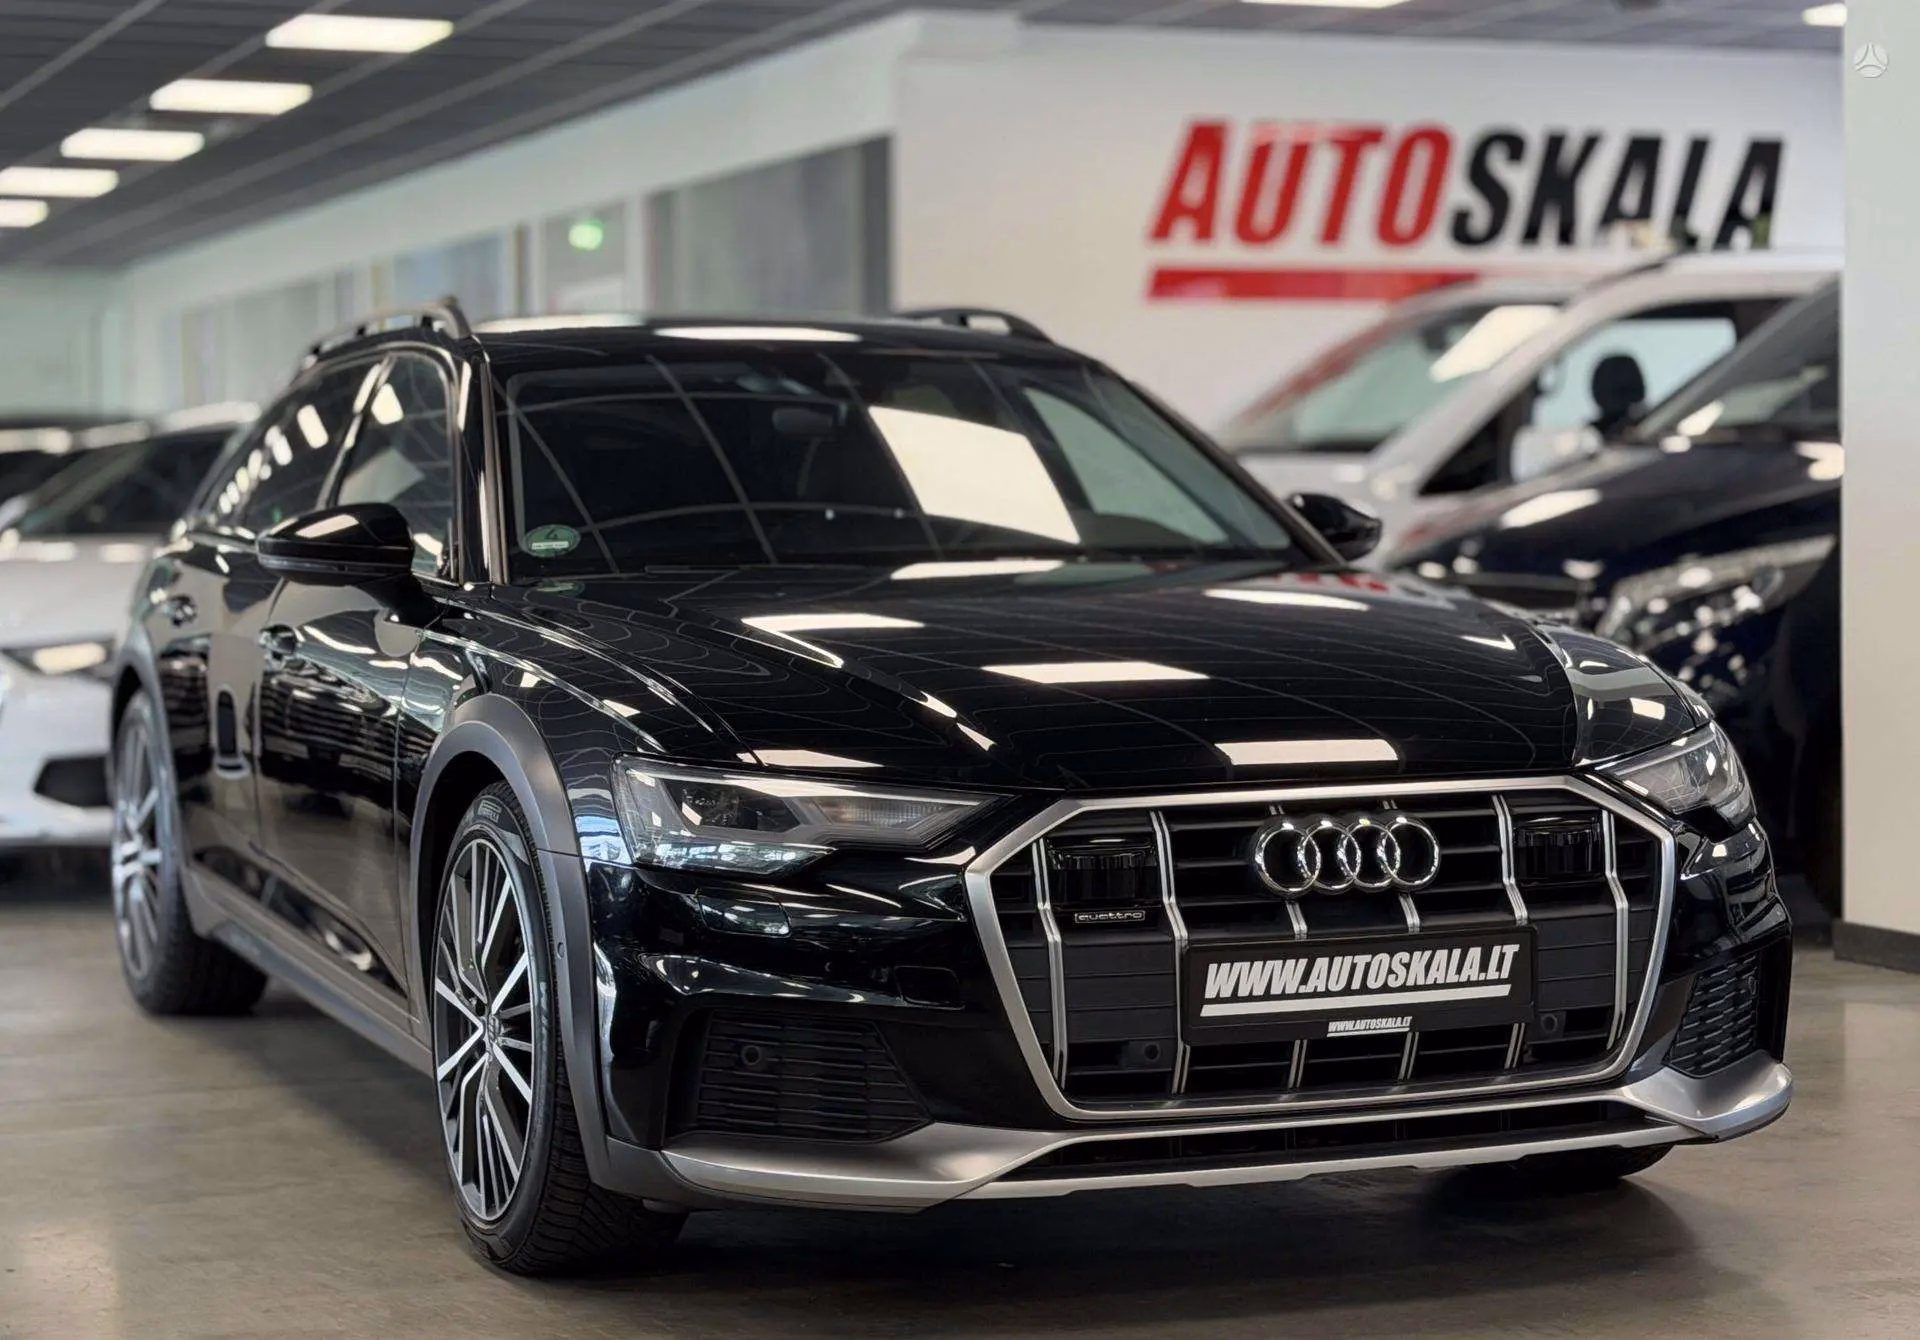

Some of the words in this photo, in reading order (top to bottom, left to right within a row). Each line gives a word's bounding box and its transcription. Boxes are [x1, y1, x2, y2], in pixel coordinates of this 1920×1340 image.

[1147, 121, 1786, 251] AUTOSKALA
[1078, 911, 1143, 922] quattro
[1204, 944, 1520, 999] WWW.AUTOSKALA.LT
[1328, 1016, 1412, 1032] WWW.AUTOSKALA.LT
